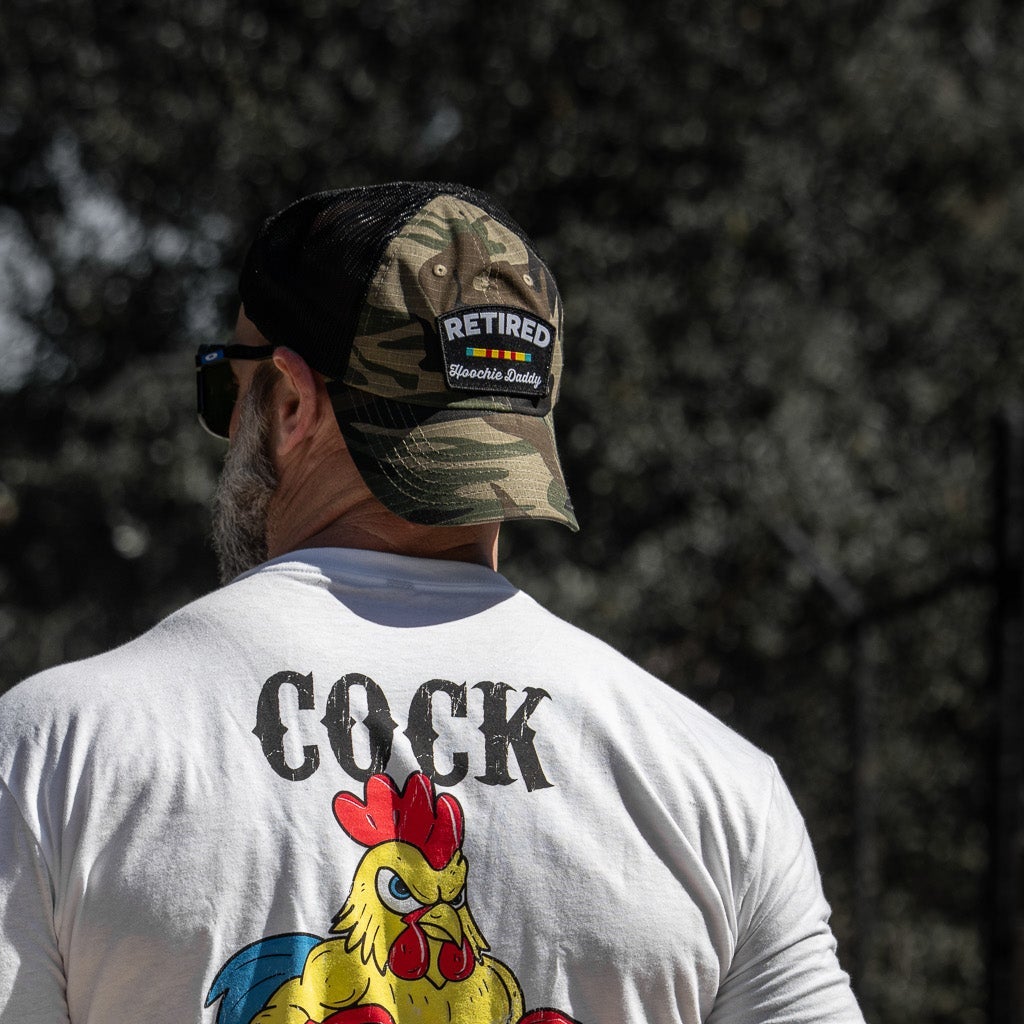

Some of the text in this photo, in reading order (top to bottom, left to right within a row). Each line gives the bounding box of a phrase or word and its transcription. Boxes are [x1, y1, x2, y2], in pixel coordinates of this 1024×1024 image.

[444, 312, 551, 348] RETIRED
[449, 363, 542, 389] Hoochie Daddy
[252, 670, 555, 793] COCK
